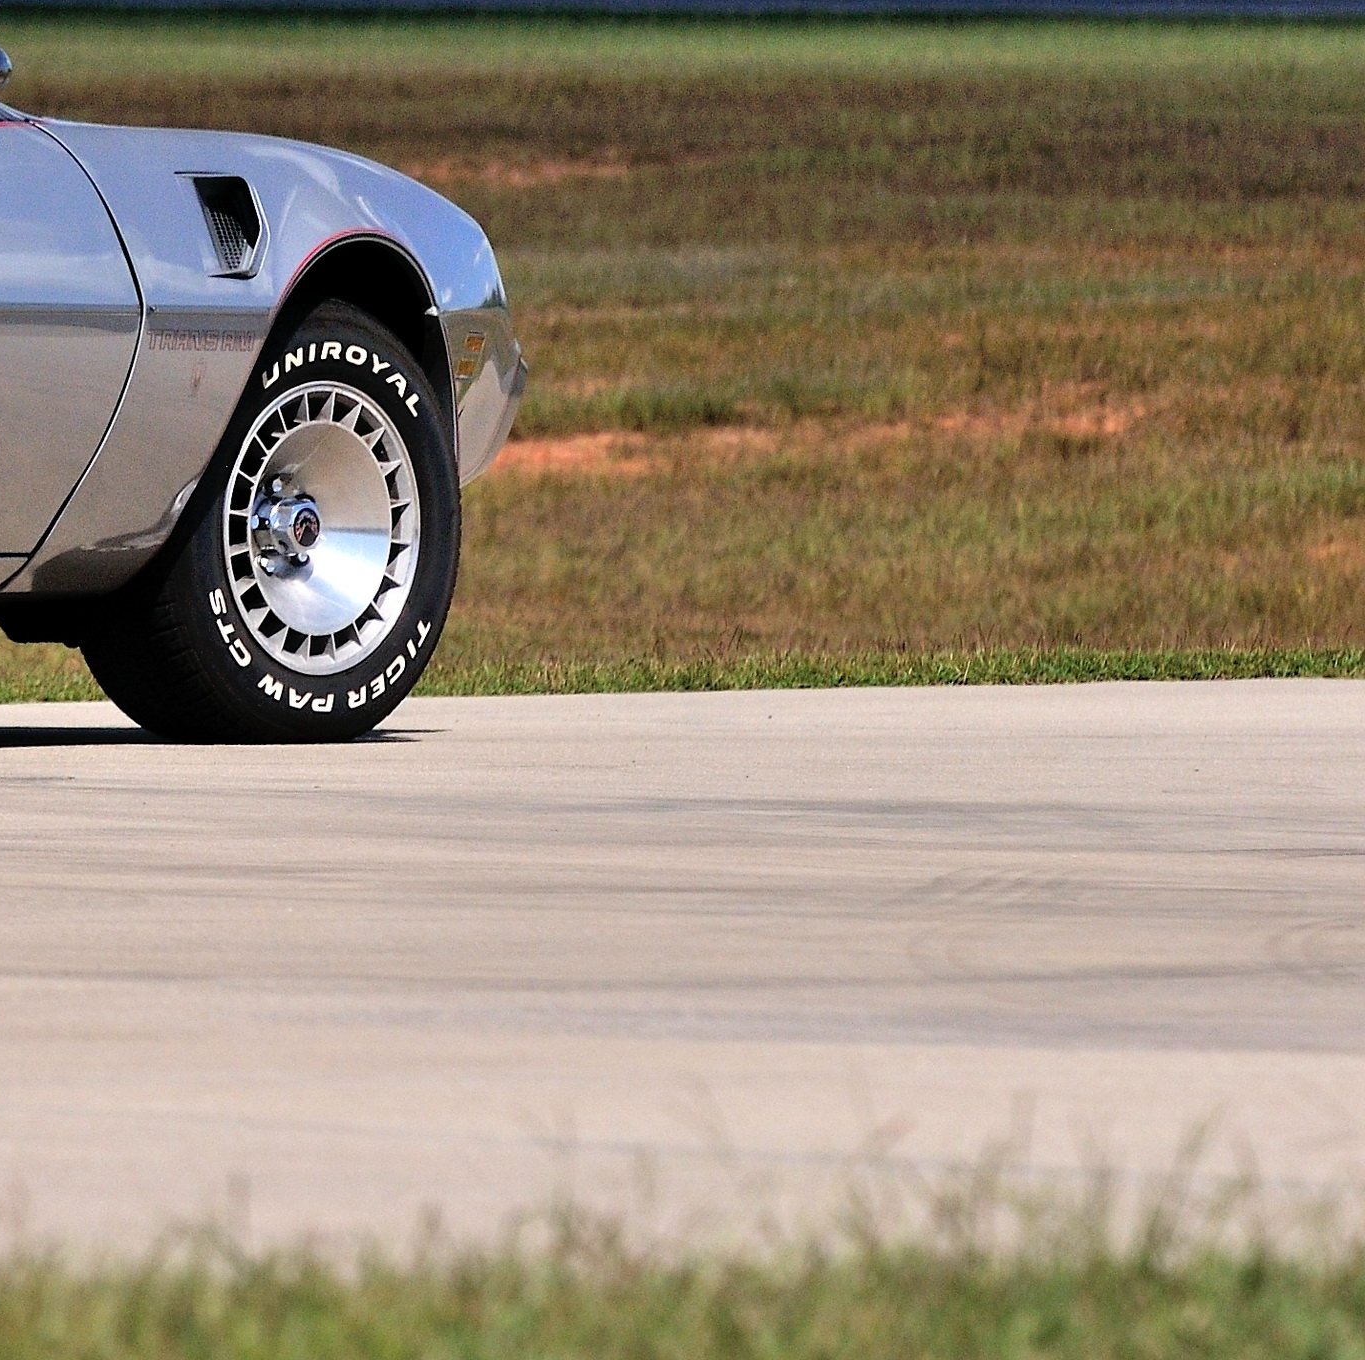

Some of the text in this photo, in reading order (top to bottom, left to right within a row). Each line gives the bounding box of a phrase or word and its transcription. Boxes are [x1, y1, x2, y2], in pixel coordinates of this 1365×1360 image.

[146, 329, 256, 352] TRANS AM
[262, 340, 419, 418] UNIROYAL
[209, 587, 433, 712] TIGER PAW GTS
